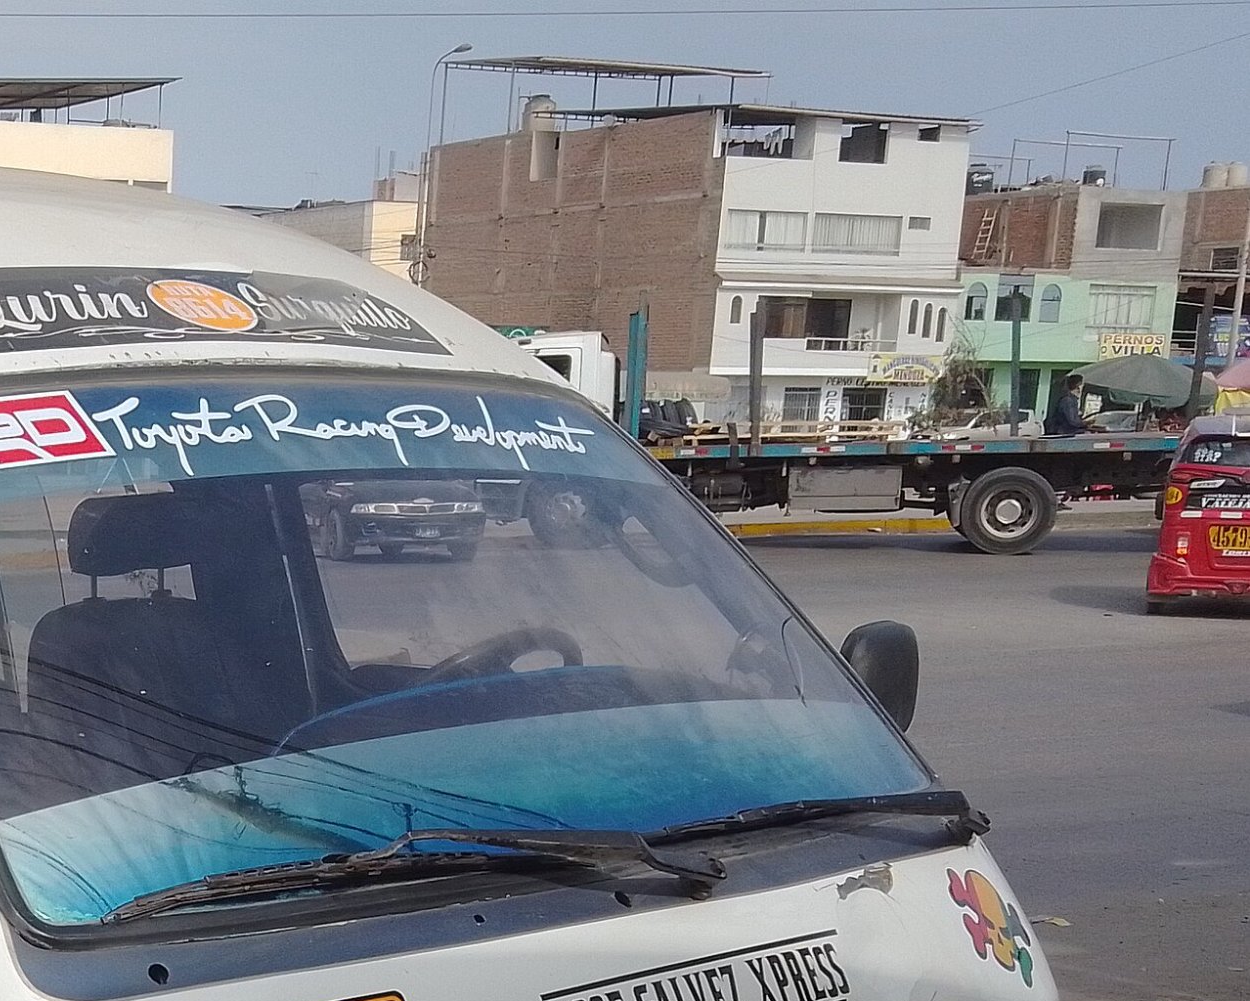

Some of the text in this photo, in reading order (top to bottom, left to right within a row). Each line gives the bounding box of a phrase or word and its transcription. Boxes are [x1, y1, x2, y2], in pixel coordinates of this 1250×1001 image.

[163, 297, 254, 321] 8614
[1103, 334, 1164, 345] PERNOS
[1111, 345, 1161, 356] VILLA
[92, 396, 253, 476] Toyota
[234, 394, 410, 467] Racing
[386, 396, 595, 471] Development
[1212, 526, 1250, 549] 4579
